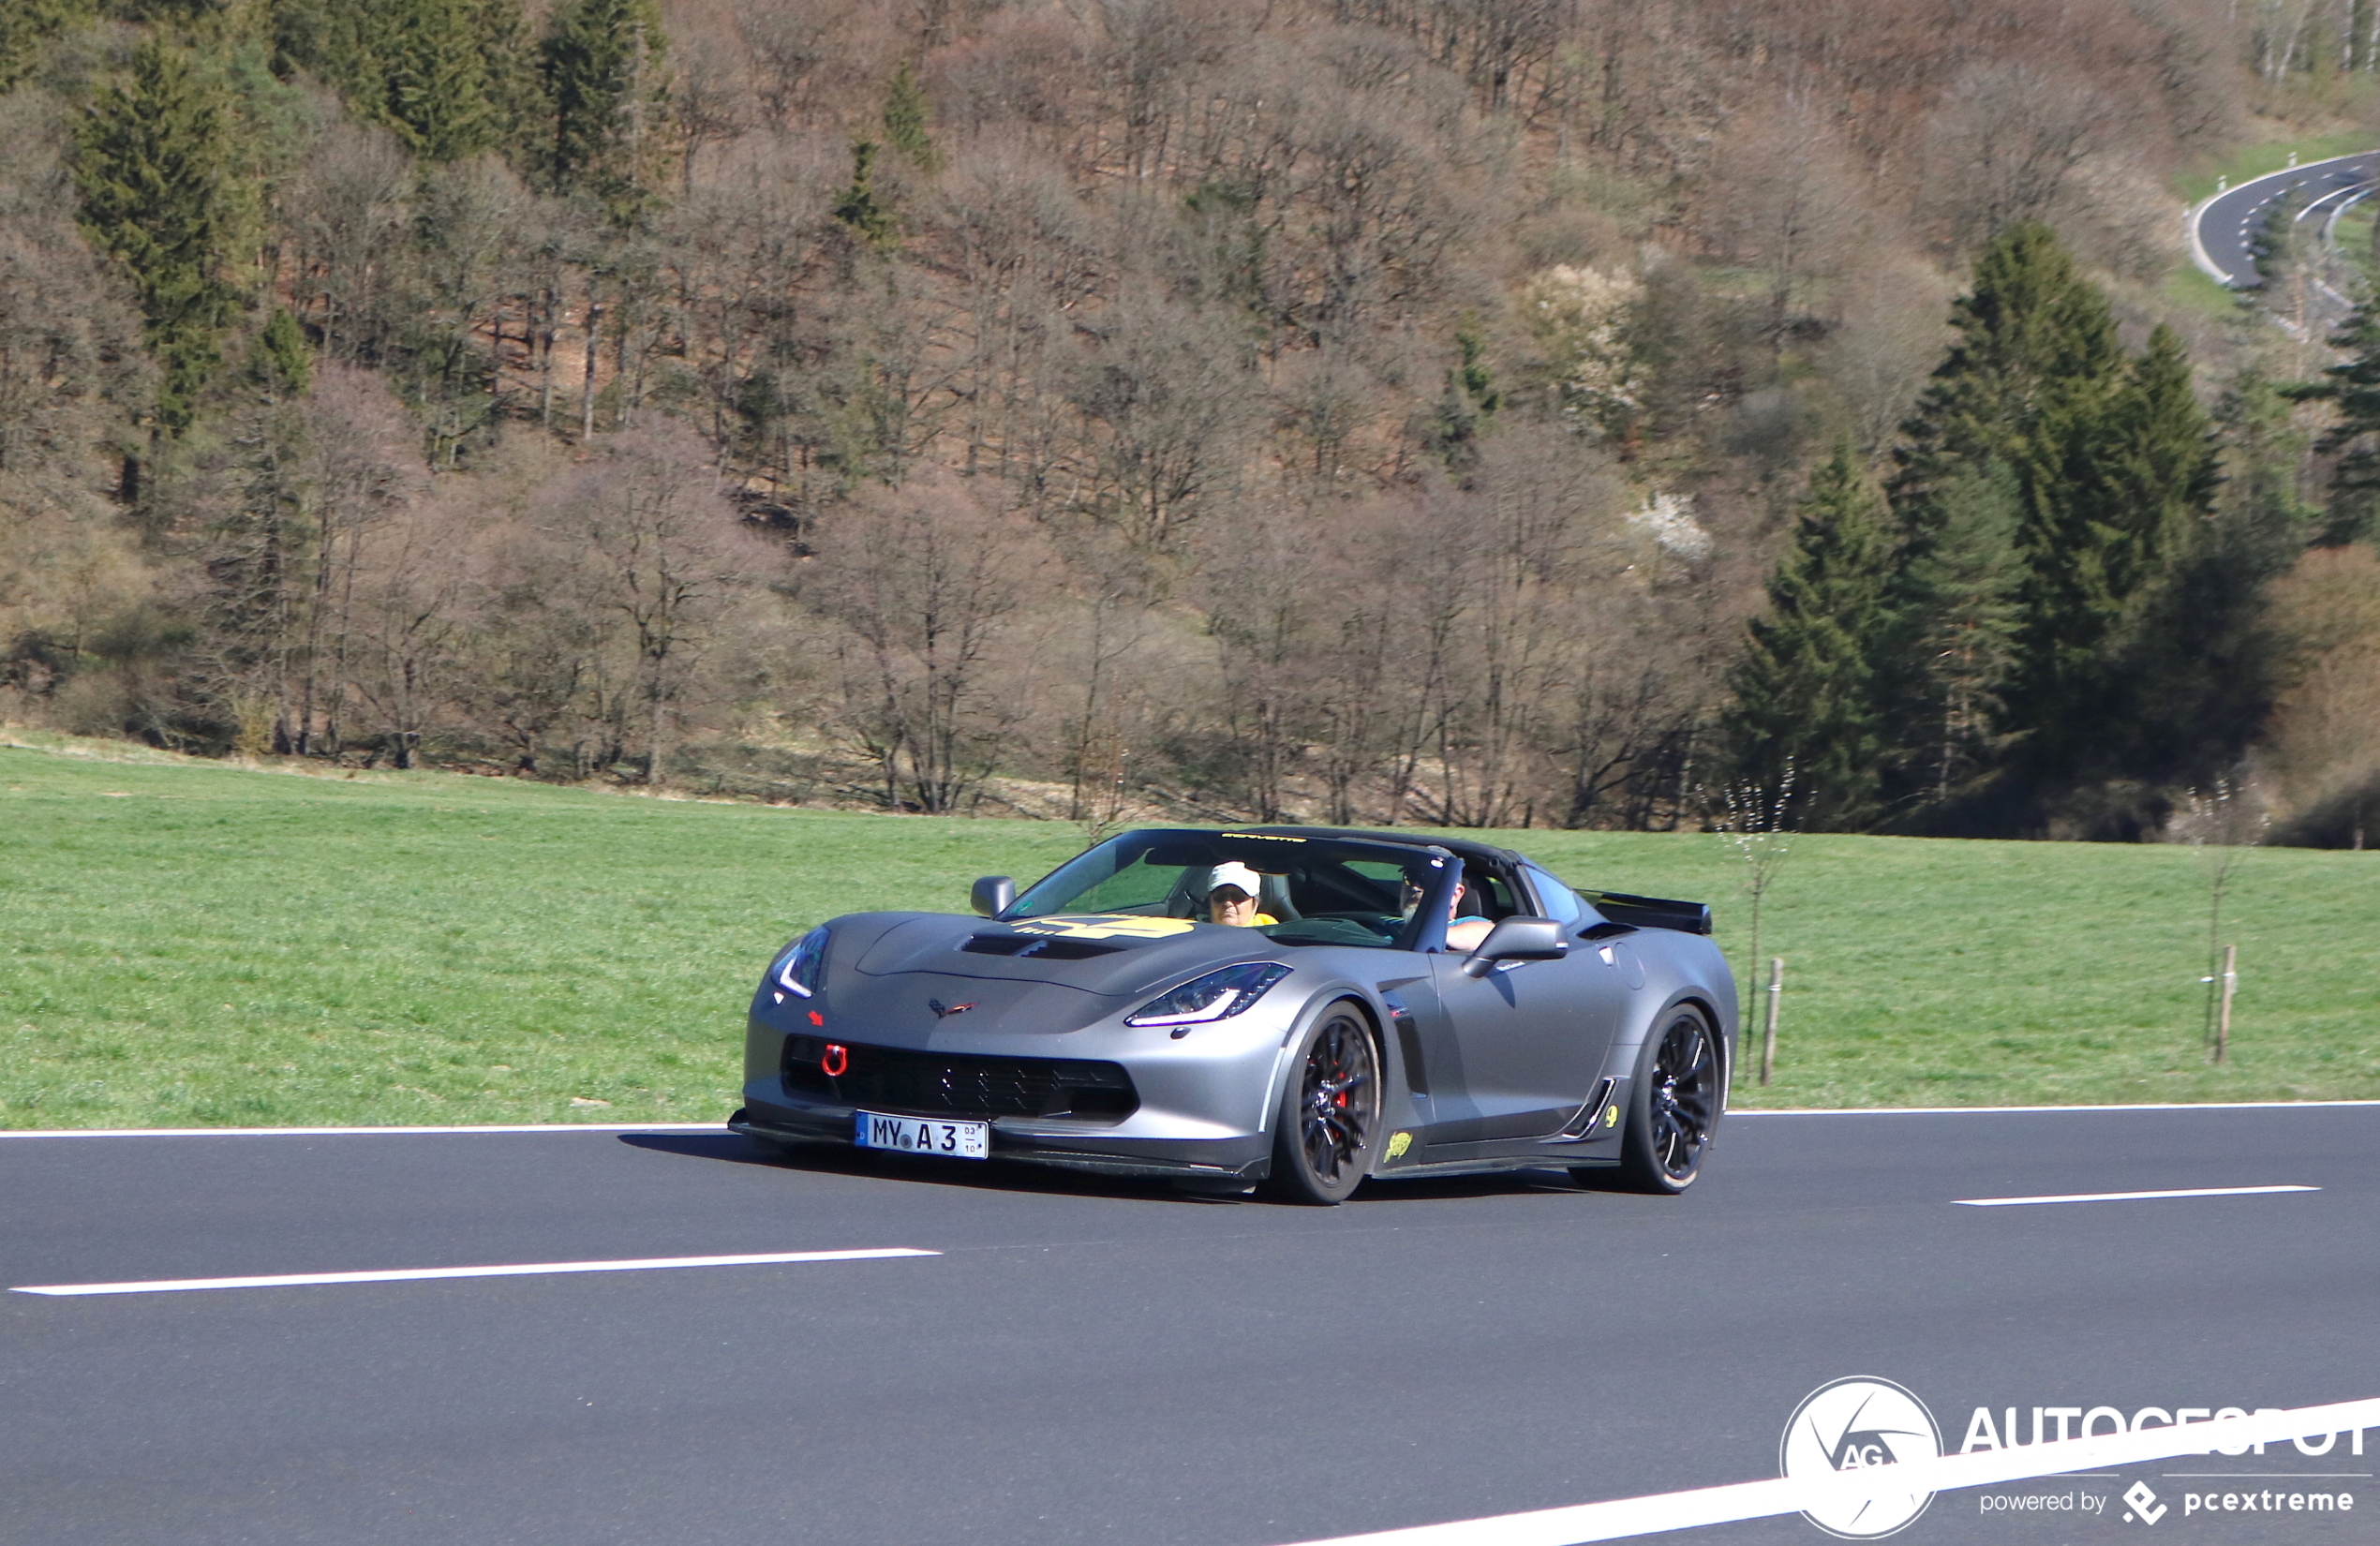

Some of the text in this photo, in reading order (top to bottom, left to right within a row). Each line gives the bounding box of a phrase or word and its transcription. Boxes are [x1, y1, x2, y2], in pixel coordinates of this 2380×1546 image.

[873, 1118, 957, 1152] MY A 3
[964, 1126, 975, 1135] 03
[965, 1145, 975, 1153] 10
